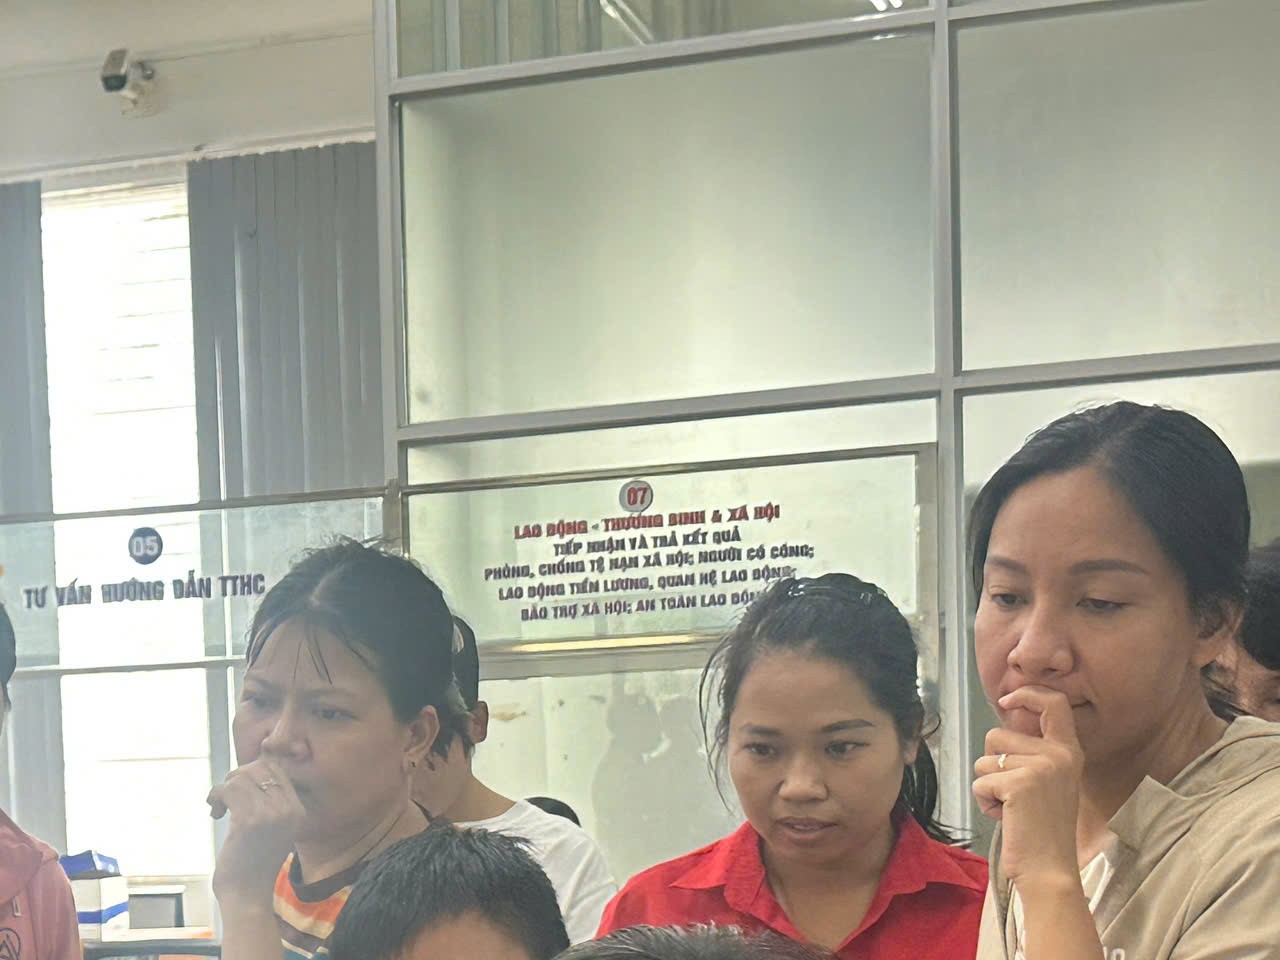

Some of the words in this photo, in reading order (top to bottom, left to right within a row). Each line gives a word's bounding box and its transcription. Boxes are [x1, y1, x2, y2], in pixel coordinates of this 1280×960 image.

[627, 487, 647, 506] 07
[514, 524, 543, 540] LAO
[132, 536, 159, 557] 05
[24, 584, 48, 609] TƯ
[56, 578, 92, 606] VẤN
[173, 570, 211, 599] DẪN
[218, 573, 266, 596] TTHC
[498, 587, 524, 601] LAO
[657, 573, 695, 589] QUAN
[721, 569, 747, 583] LAO
